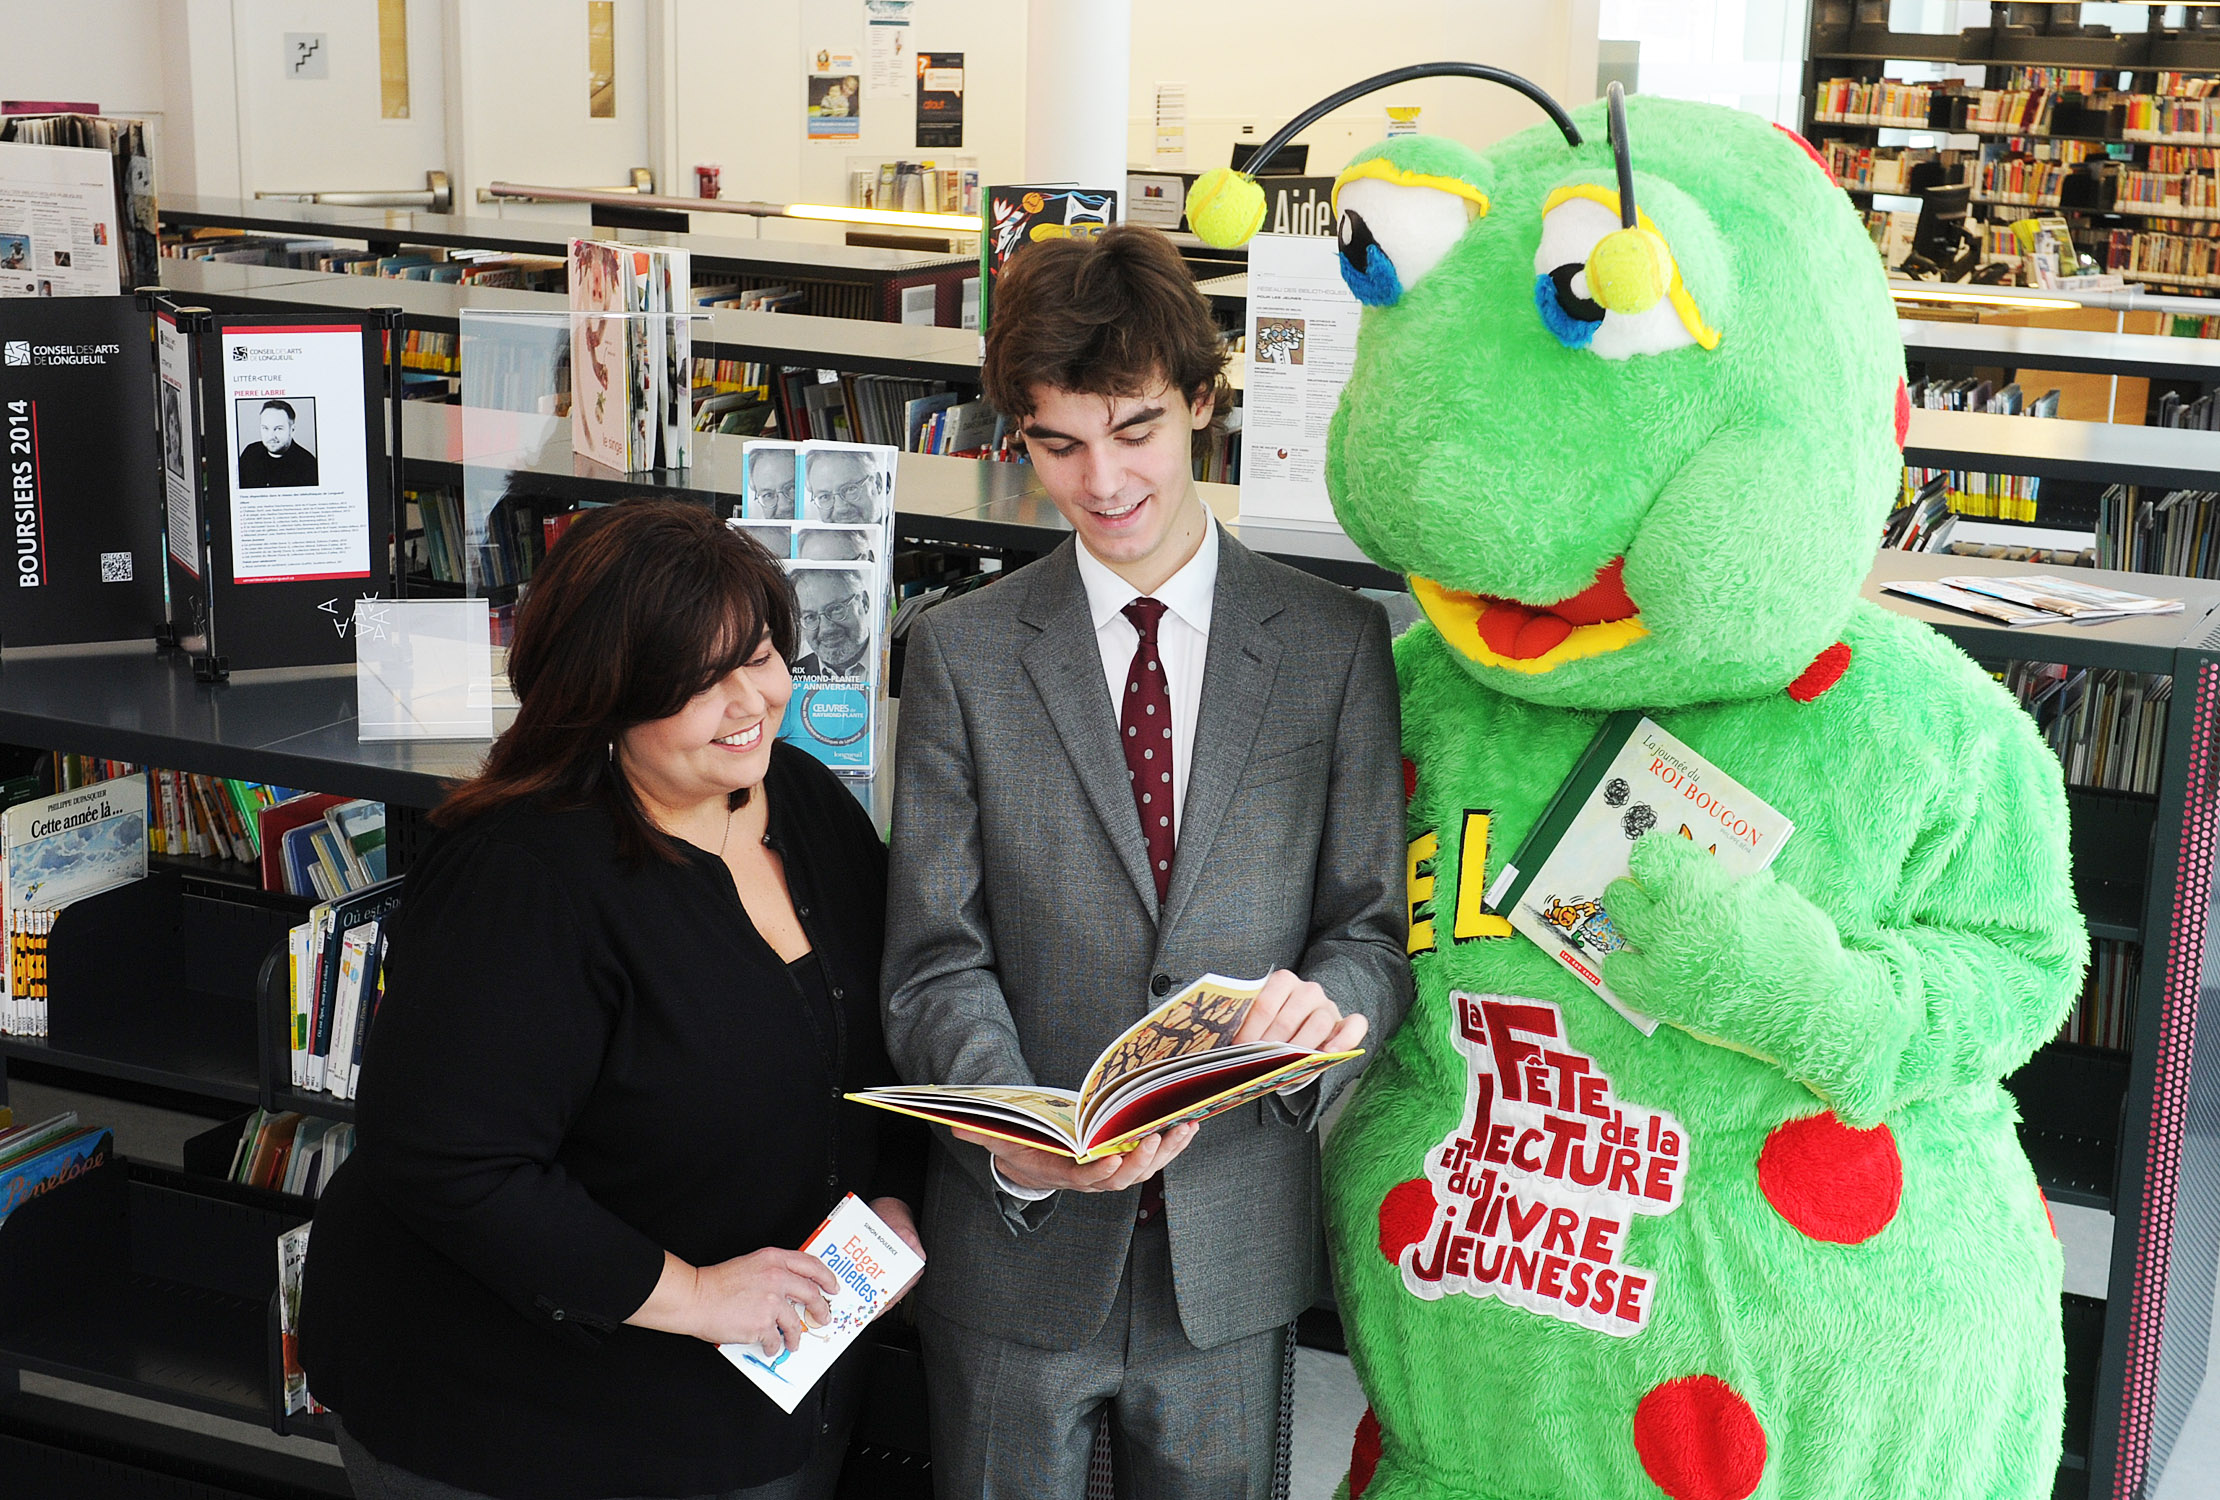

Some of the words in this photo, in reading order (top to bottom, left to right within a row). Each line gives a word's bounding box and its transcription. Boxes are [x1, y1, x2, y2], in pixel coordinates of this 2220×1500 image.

[1273, 188, 1330, 236] Aide
[33, 346, 75, 355] CONSEIL
[76, 345, 94, 354] DES
[95, 344, 120, 354] ARTS
[34, 356, 47, 365] DE
[48, 355, 106, 365] LONGUEUIL
[7, 400, 31, 454] 2014
[11, 461, 40, 587] BOURSIERS
[792, 666, 805, 674] RIX
[812, 704, 849, 712] ŒUVRES
[1642, 734, 1656, 750] La
[1651, 743, 1688, 774] journée
[1687, 766, 1700, 783] du
[47, 799, 73, 813] PHILIPPE
[73, 789, 107, 805] DUPASQUIER
[1649, 757, 1683, 790] ROI
[1683, 782, 1763, 847] BOUGON
[31, 819, 61, 838] Cette
[64, 806, 98, 829] année
[344, 907, 360, 927] Où
[364, 902, 381, 920] est
[384, 896, 401, 913] Sp
[1481, 1000, 1611, 1120] FÊTE
[1647, 1115, 1680, 1157] la
[1440, 1137, 1473, 1172] ET
[864, 1222, 877, 1237] SIMON
[877, 1236, 898, 1256] BOULERICE
[820, 1243, 877, 1303] Paillettes
[842, 1235, 885, 1280] Edgar
